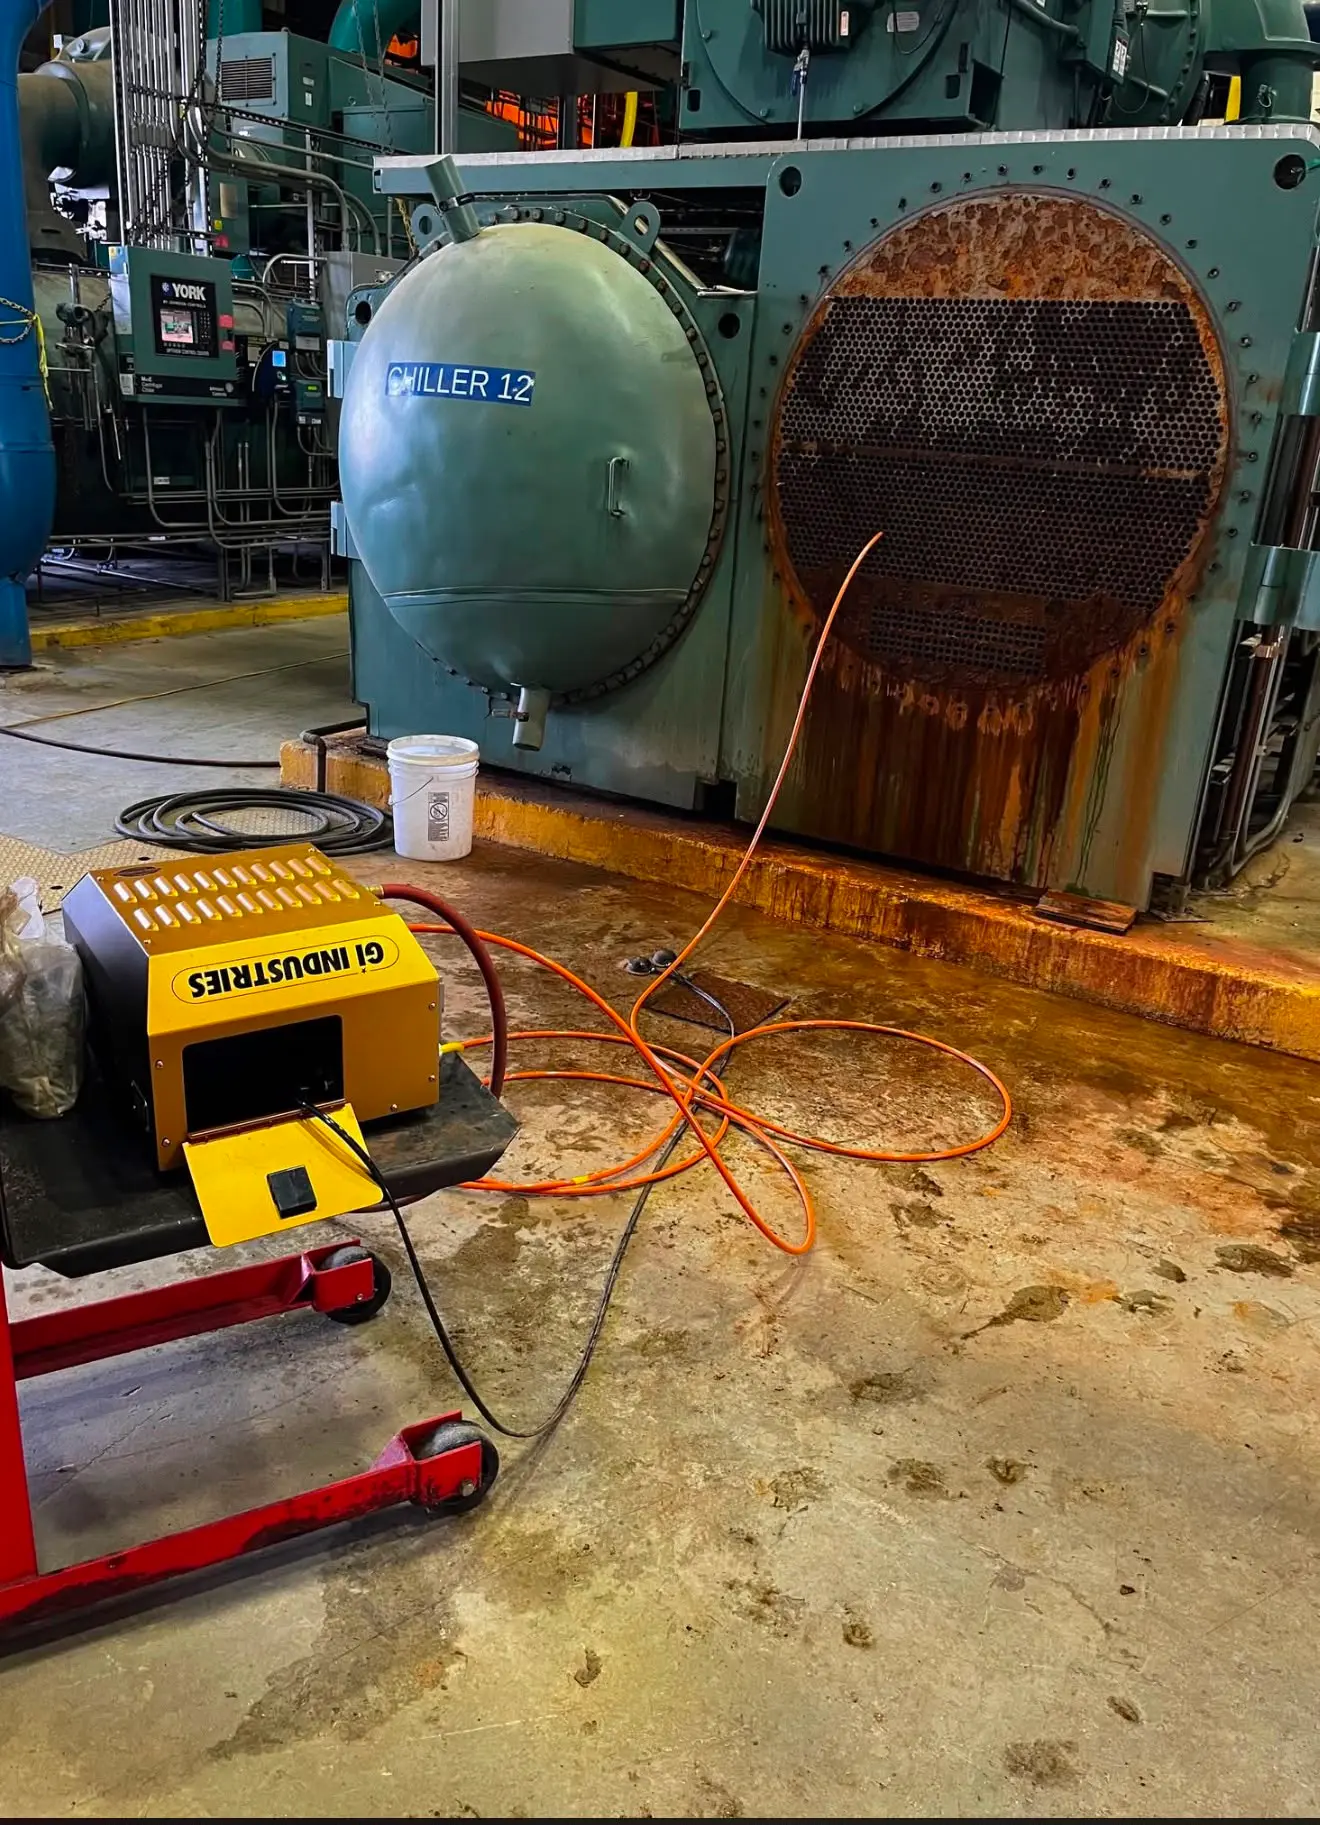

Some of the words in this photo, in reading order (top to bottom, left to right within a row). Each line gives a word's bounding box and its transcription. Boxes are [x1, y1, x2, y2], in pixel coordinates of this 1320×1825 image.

[172, 282, 206, 301] YORK
[387, 366, 489, 397] CHILLER
[498, 374, 533, 402] 12
[187, 946, 350, 999] INDUSTRIES
